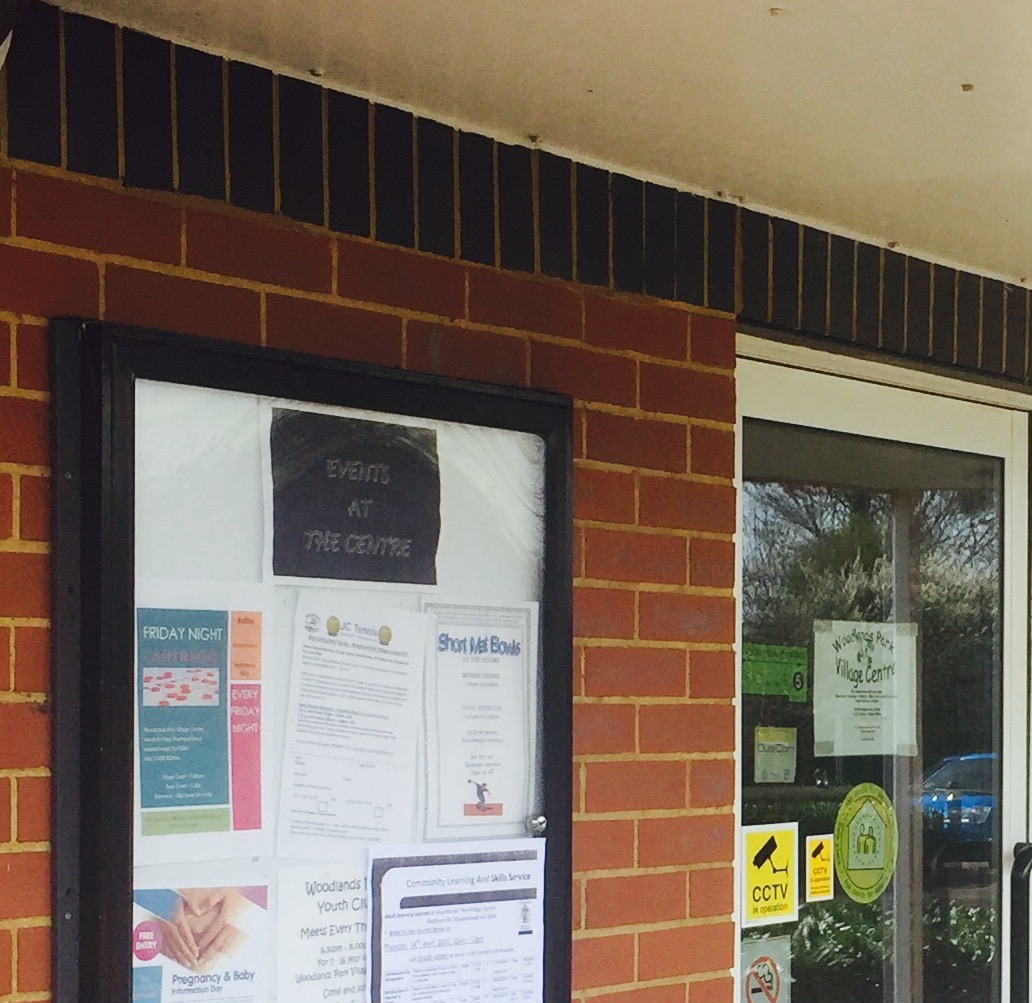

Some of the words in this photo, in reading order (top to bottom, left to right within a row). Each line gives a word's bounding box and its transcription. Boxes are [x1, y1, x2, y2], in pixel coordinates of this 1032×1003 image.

[326, 458, 391, 485] EVENTS
[347, 498, 374, 518] AT
[304, 529, 342, 553] THE
[345, 533, 412, 558] CENTRE
[143, 626, 186, 640] FRIDAY
[188, 627, 223, 641] NIGHT
[353, 623, 378, 637] Tennis
[438, 632, 468, 655] Short
[469, 636, 489, 655] Mat
[490, 635, 521, 656] Bowls
[831, 628, 875, 653] Woodlands
[875, 631, 895, 655] Park
[835, 655, 864, 688] Village
[865, 662, 896, 684] Centre
[231, 689, 259, 699] EVERY
[230, 706, 260, 716] FRIDAY
[231, 723, 259, 733] NIGHT
[813, 866, 828, 875] CCTV
[305, 878, 361, 896] Woodlands
[406, 878, 446, 889] Community
[446, 877, 475, 886] Learning
[490, 873, 507, 883] Skills
[508, 873, 531, 881] Service
[752, 883, 788, 903] CCTV
[316, 898, 348, 915] Youth
[752, 905, 760, 914] in
[760, 903, 788, 914] operation
[138, 931, 155, 940] FREE
[300, 925, 328, 940] Meets
[329, 923, 353, 937] Every
[135, 940, 157, 950] ENTRY
[172, 972, 222, 987] Pregnancy
[223, 971, 231, 982] &
[233, 969, 256, 983] Baby
[171, 986, 210, 996] Information
[210, 984, 224, 994] Day
